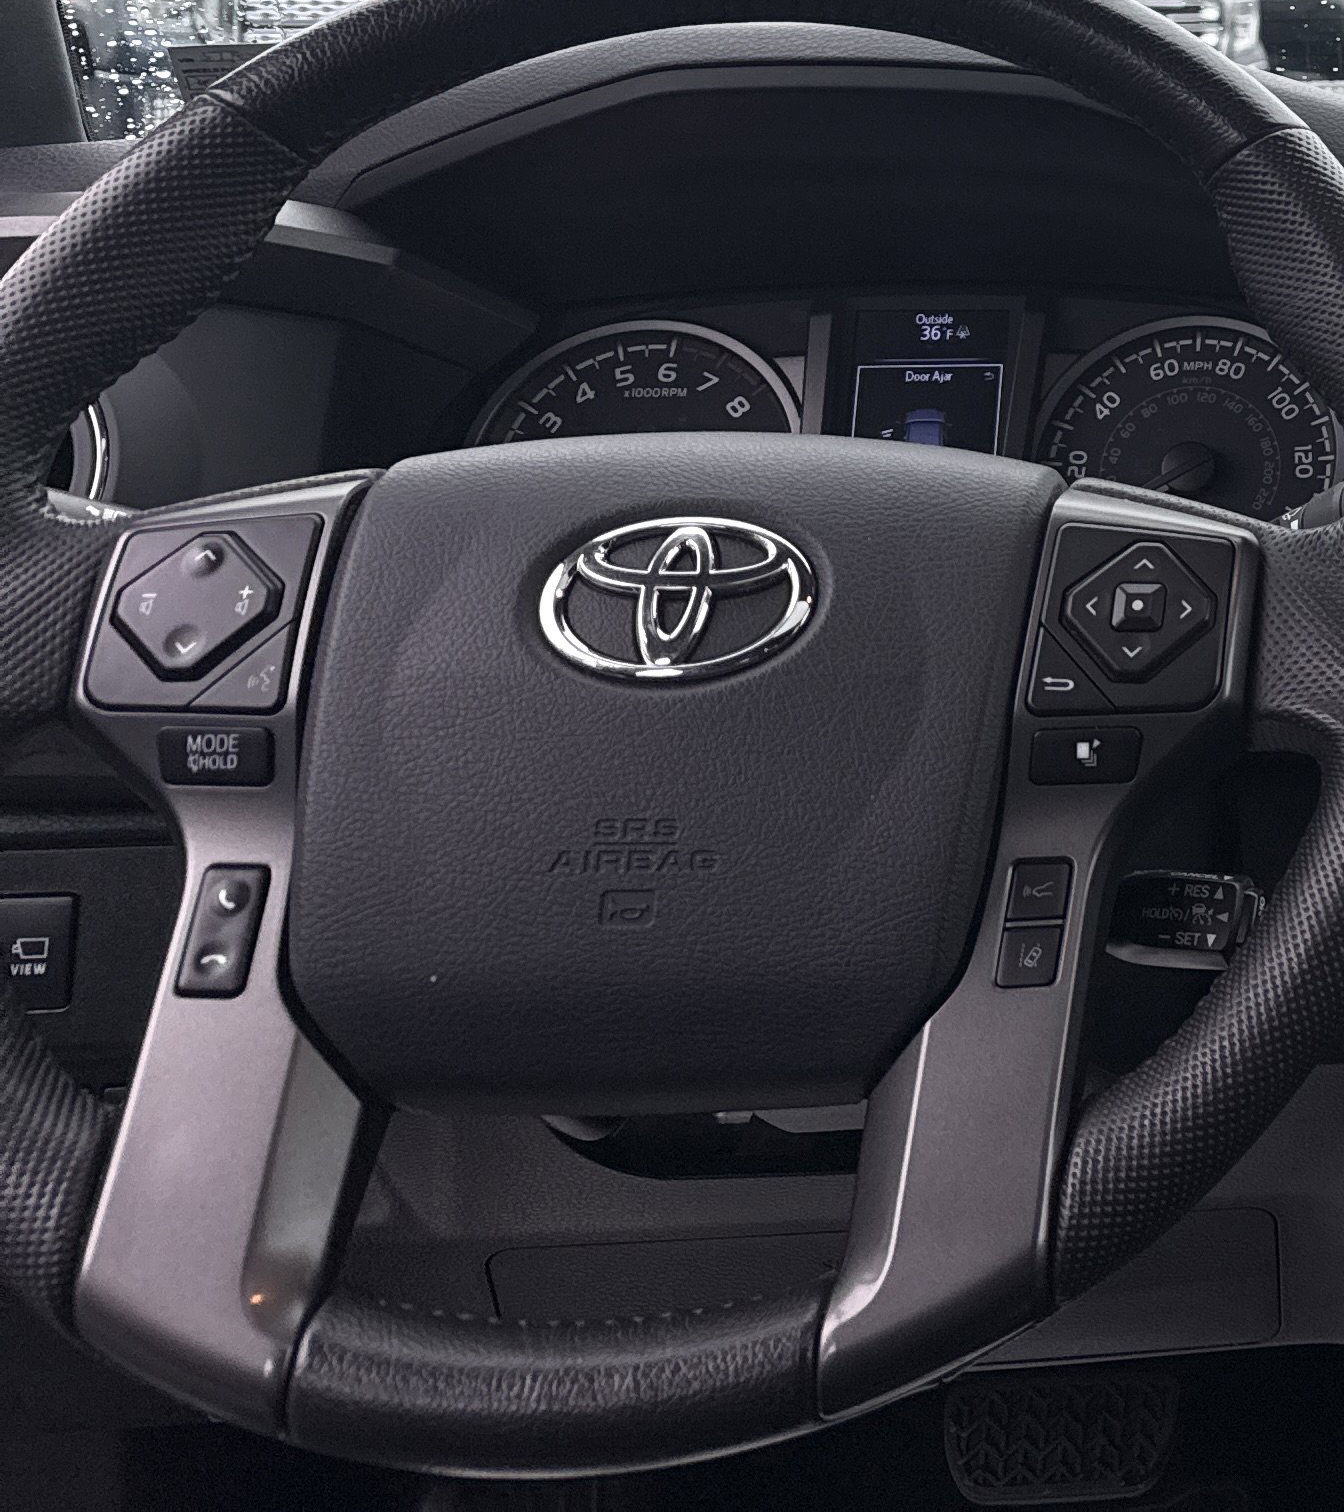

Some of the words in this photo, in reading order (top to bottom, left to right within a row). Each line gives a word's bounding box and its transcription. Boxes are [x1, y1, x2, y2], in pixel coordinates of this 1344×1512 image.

[915, 312, 954, 325] Outside
[613, 364, 636, 388] 5
[656, 362, 679, 383] 6
[904, 370, 931, 383] Door
[932, 370, 953, 384] Ajar
[1149, 358, 1181, 381] 60
[1183, 361, 1214, 372] MPH
[1215, 358, 1247, 380] 80
[695, 371, 721, 393] 7
[574, 381, 597, 405] 4
[1166, 392, 1189, 406] 100
[1196, 392, 1217, 405] 120
[1266, 385, 1300, 421] 100
[725, 394, 751, 419] 8
[1094, 391, 1122, 421] 40
[1140, 402, 1159, 419] 80
[537, 410, 564, 435] 3
[1066, 449, 1089, 479] 20
[1293, 443, 1315, 480] 120
[186, 734, 241, 754] MODE
[198, 753, 239, 771] HOLD
[593, 817, 680, 840] SRS
[547, 848, 720, 875] AIRBAG
[1183, 883, 1211, 899] RES
[1141, 906, 1170, 921] HOLD
[1174, 931, 1202, 947] SET
[9, 962, 47, 976] VIEW
